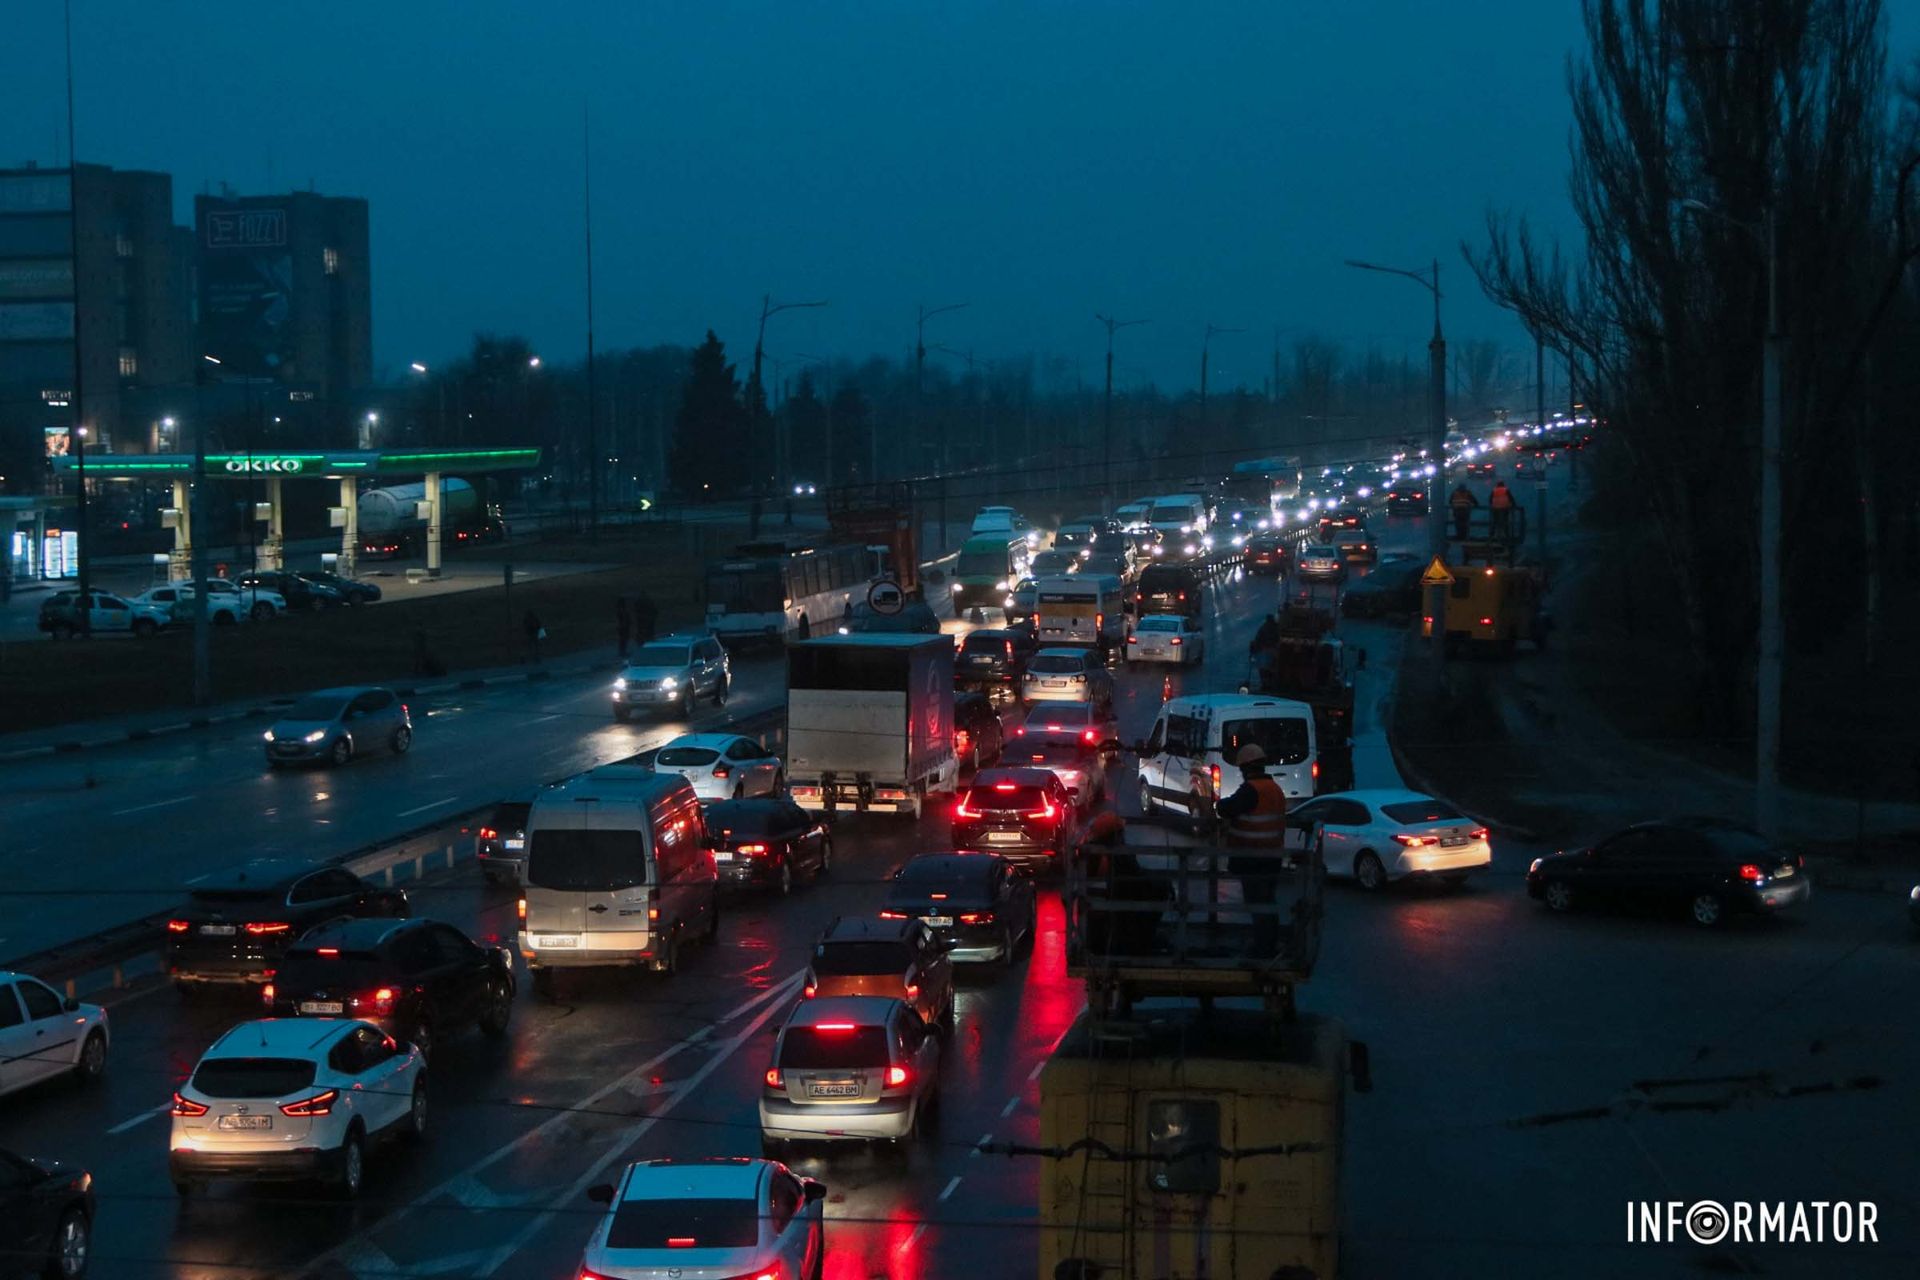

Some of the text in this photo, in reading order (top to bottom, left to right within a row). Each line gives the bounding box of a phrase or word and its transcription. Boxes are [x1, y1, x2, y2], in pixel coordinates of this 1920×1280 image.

[225, 459, 302, 474] OKKO
[814, 1086, 825, 1095] AE
[845, 1086, 858, 1094] BM
